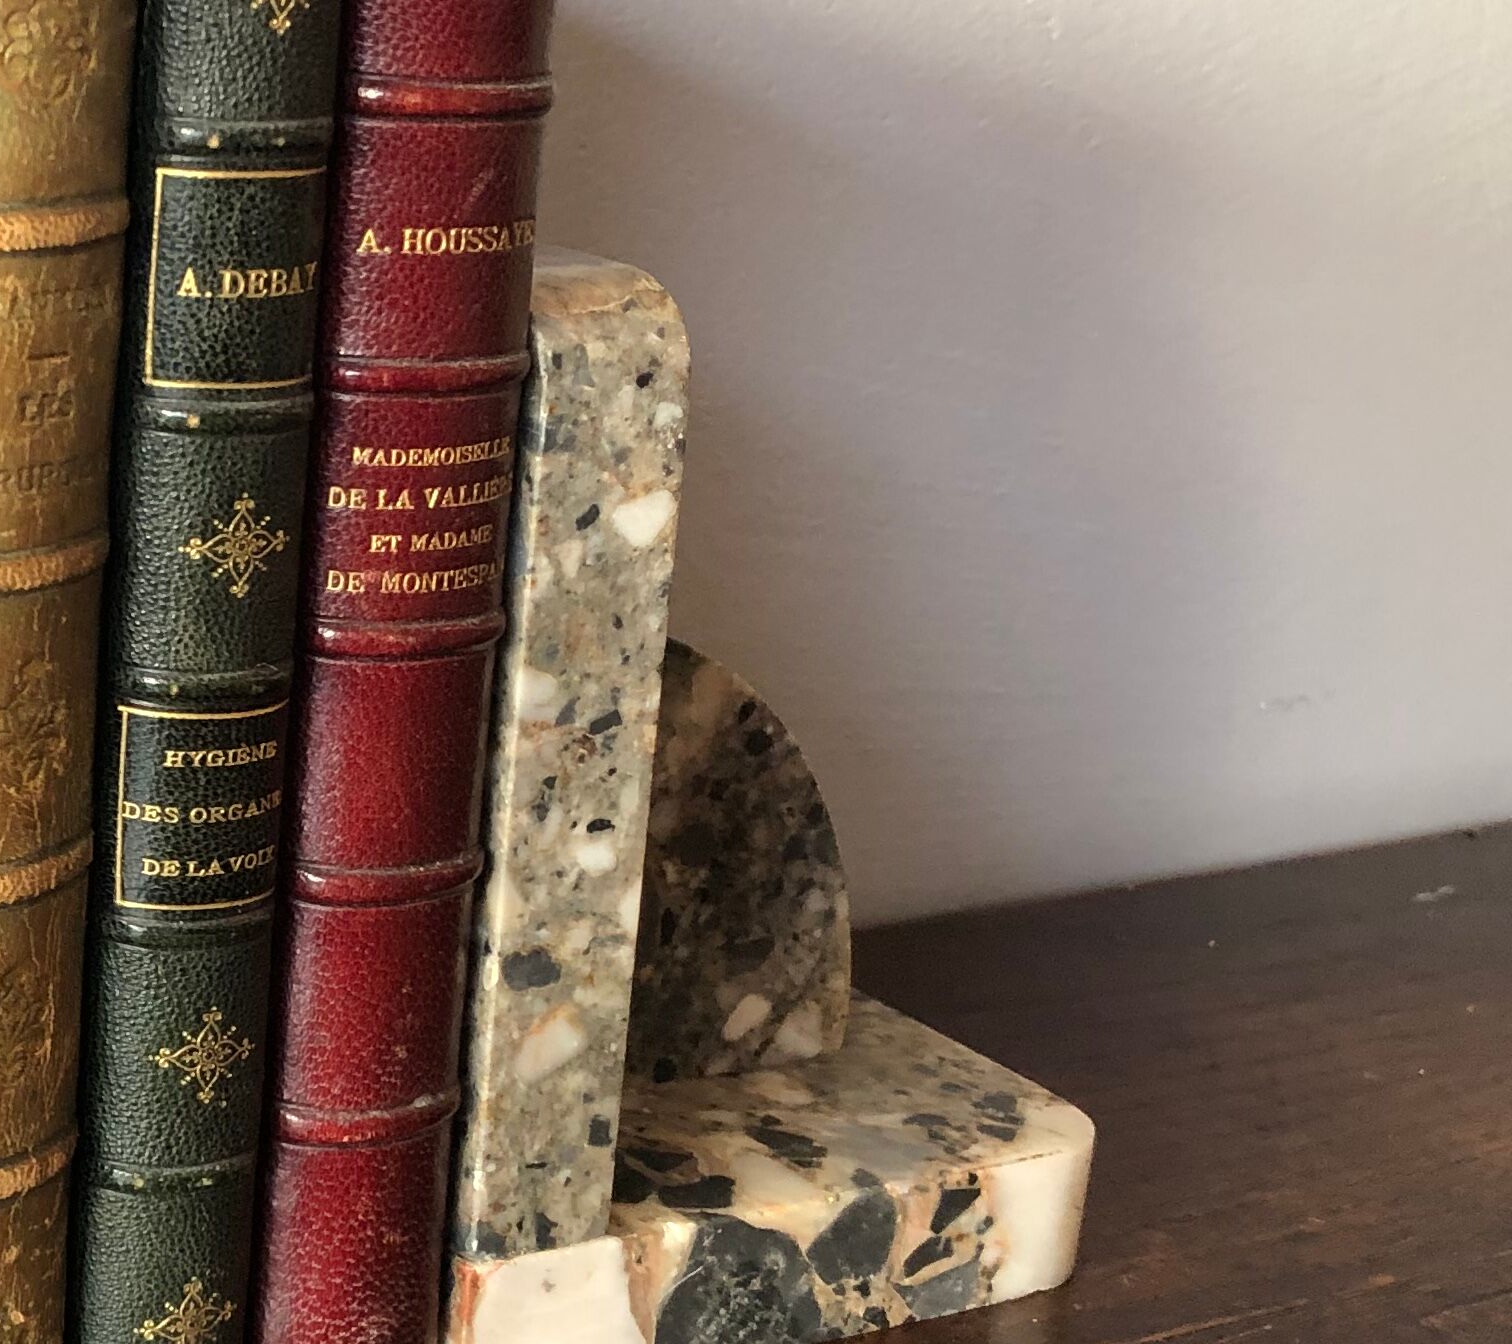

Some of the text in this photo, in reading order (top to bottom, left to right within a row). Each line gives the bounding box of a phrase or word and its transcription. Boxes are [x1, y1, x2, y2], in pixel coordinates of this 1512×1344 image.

[354, 229, 392, 254] A.
[352, 436, 511, 467] MADEMOISELLE
[328, 486, 367, 509] DE
[376, 488, 415, 510] LA
[369, 525, 493, 553] ET MADAME
[326, 570, 366, 593] DE
[163, 740, 278, 768] HYGIÈNE
[122, 801, 180, 824] DES
[141, 845, 276, 878] DE LA VOIX
